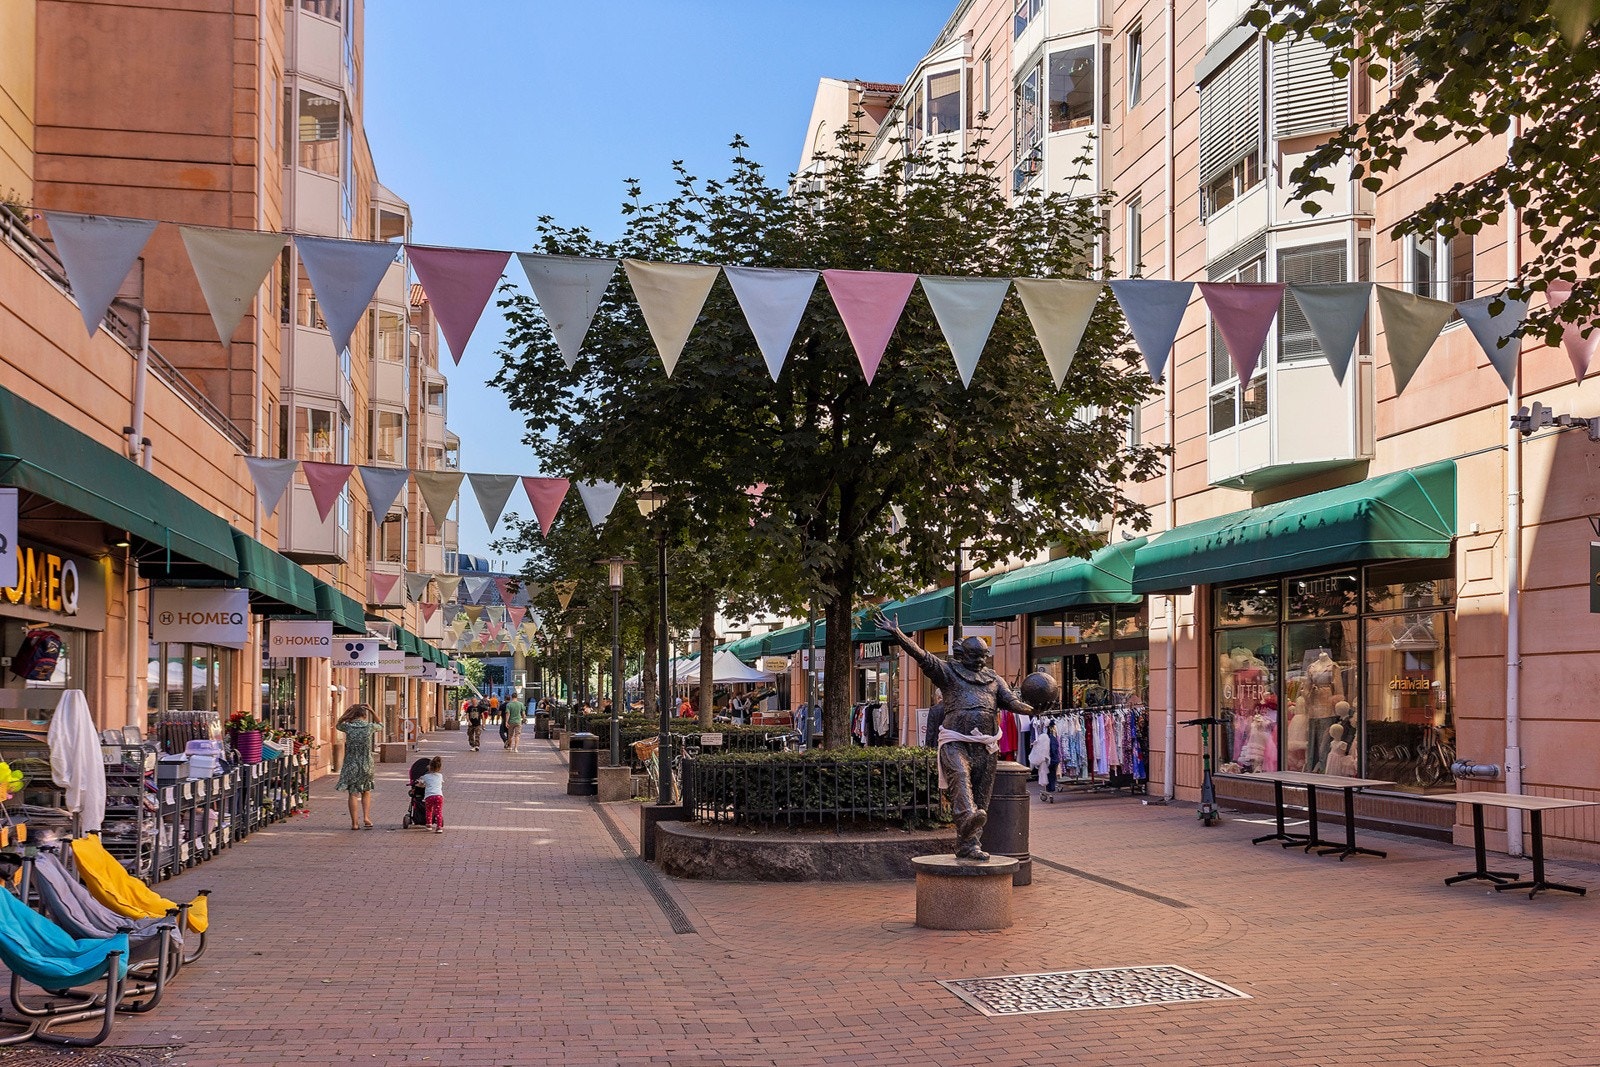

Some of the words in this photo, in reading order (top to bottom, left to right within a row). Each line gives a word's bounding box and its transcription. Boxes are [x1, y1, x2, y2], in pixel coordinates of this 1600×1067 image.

[0, 545, 79, 615] OMEQ
[1297, 577, 1337, 595] GLITTER
[178, 612, 243, 625] HOMEQ
[285, 636, 330, 646] HOMEQ
[1389, 674, 1430, 690] chaiwala
[1223, 684, 1265, 700] GLITTER
